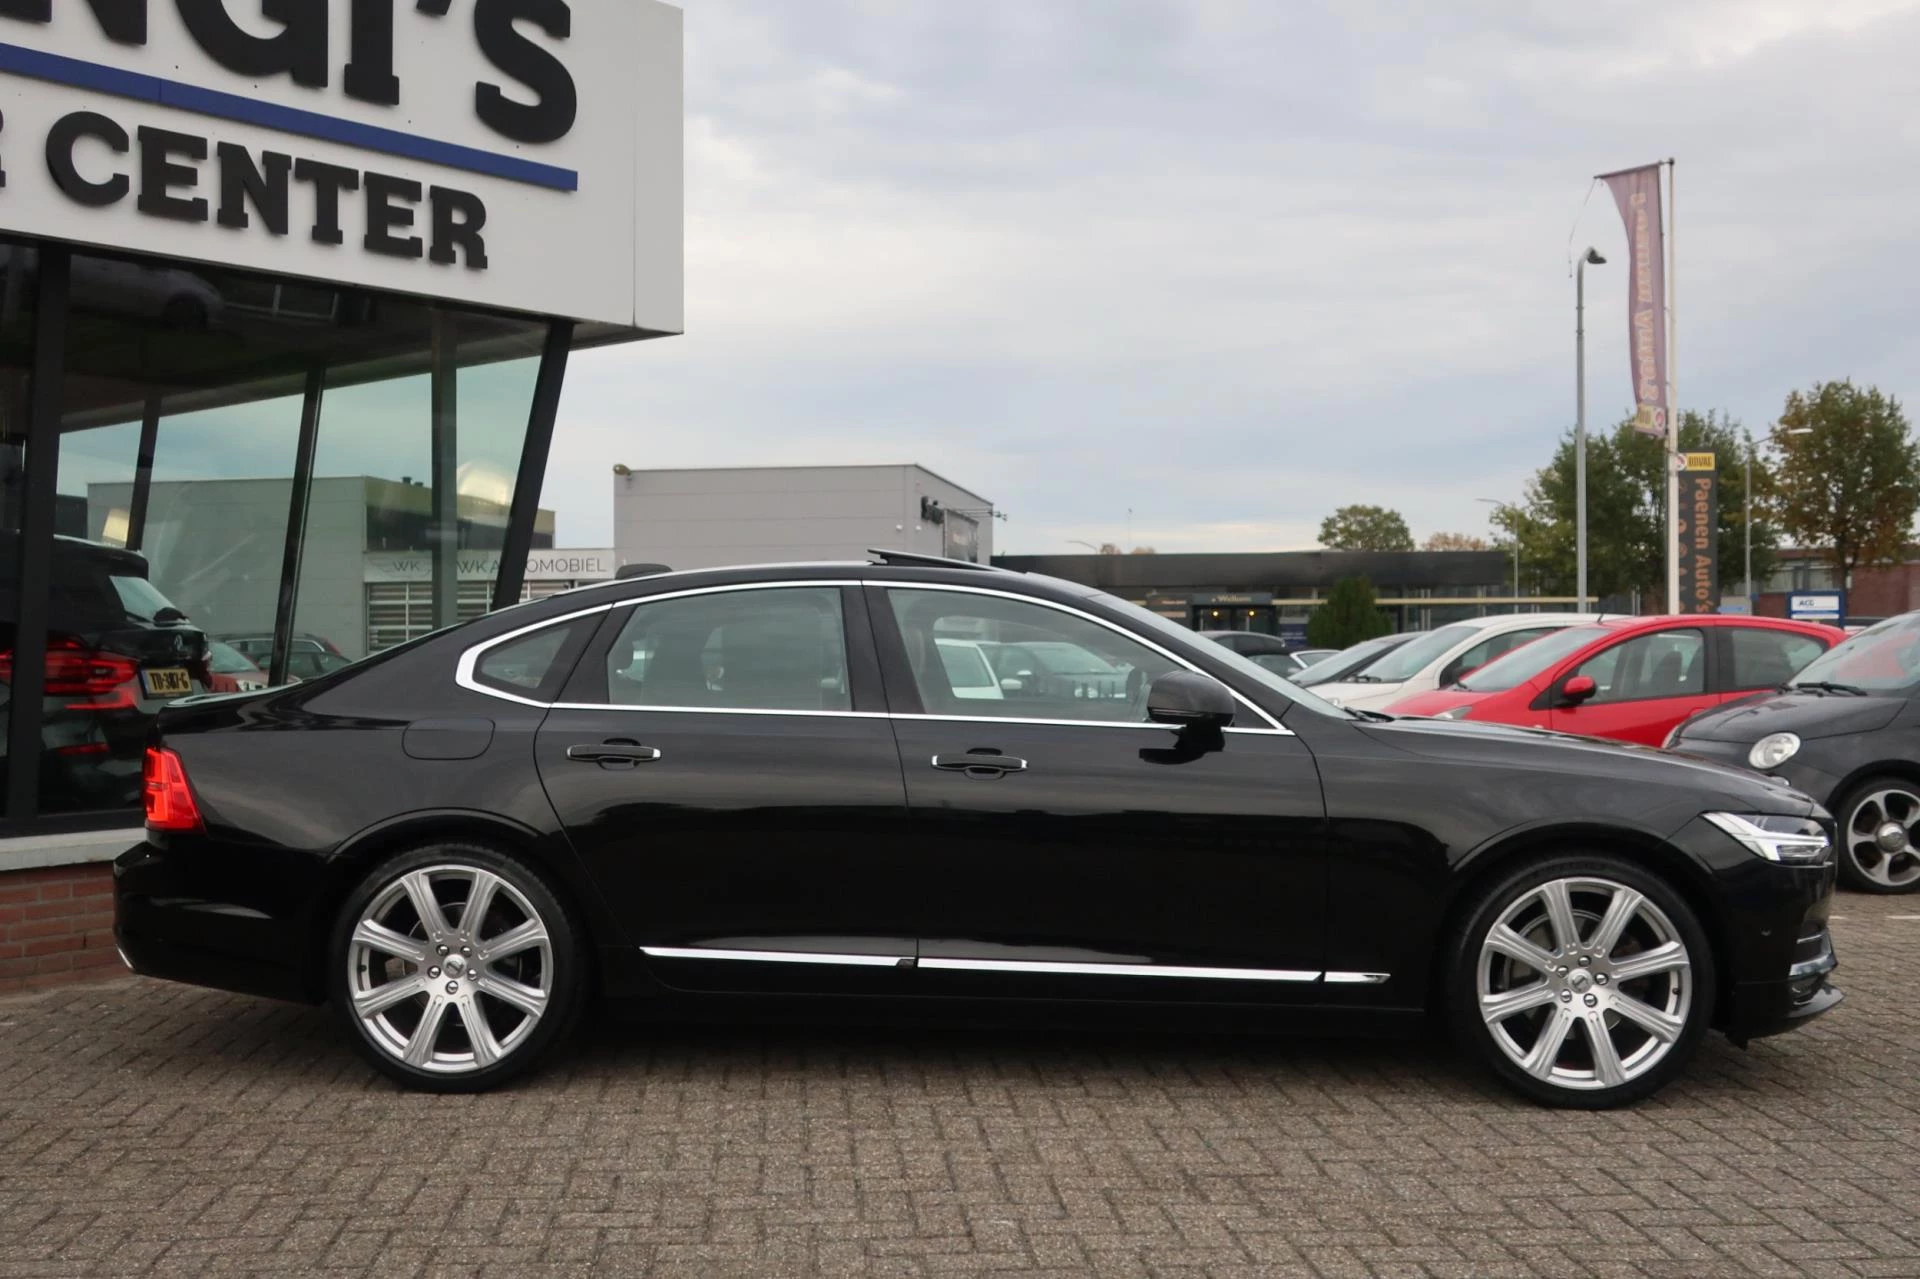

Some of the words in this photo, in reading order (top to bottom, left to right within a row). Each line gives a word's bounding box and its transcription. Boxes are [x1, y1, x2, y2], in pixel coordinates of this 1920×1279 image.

[46, 111, 487, 269] CENTER
[1694, 478, 1712, 549] Paenen
[456, 559, 487, 573] WK
[489, 558, 607, 573] AOMOBIEL
[1694, 555, 1714, 613] Auto's
